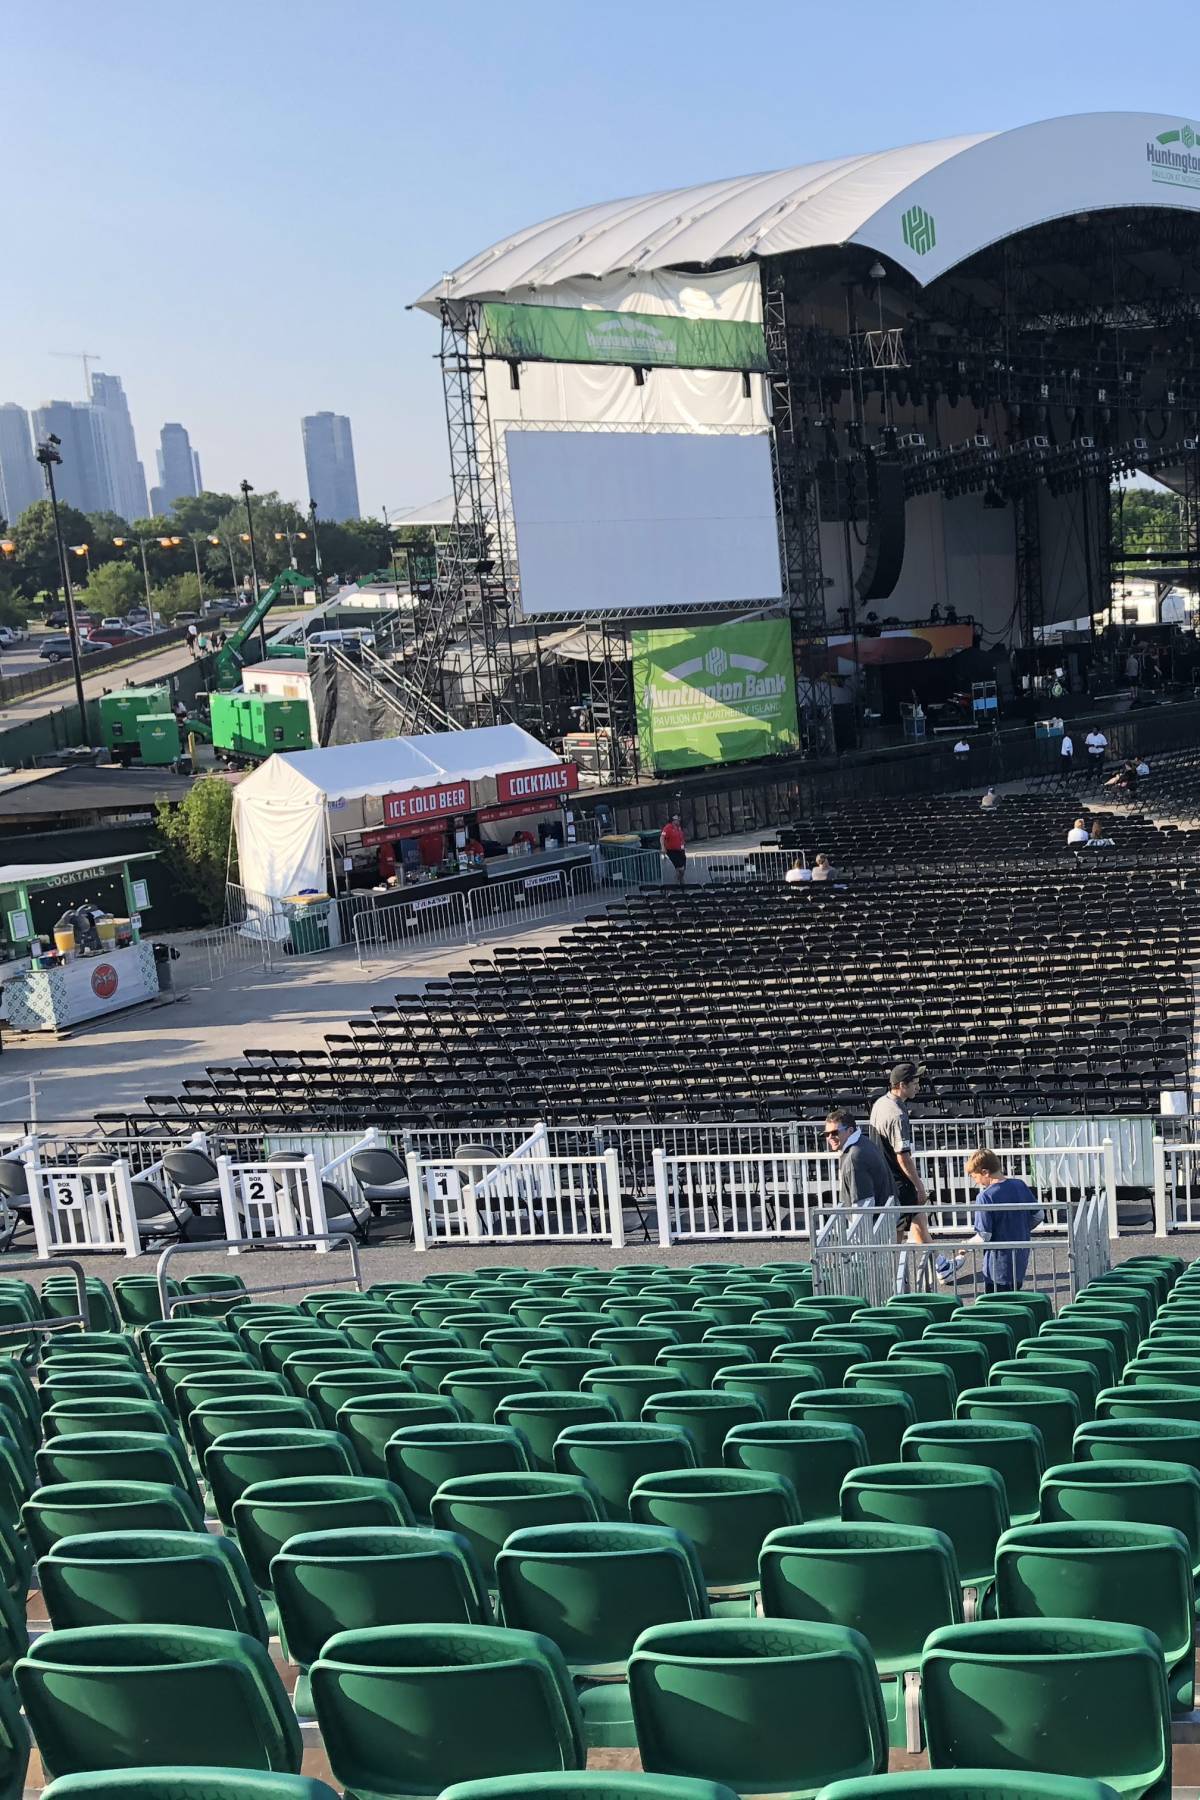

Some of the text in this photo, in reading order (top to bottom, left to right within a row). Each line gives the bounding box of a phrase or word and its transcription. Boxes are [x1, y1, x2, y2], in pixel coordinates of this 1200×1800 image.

[644, 674, 786, 708] Huntington Bank
[654, 713, 690, 726] PAVILION
[691, 711, 702, 721] AT
[509, 770, 568, 796] COCKTAILS
[389, 788, 466, 818] ICE COLD BEER
[47, 866, 106, 888] COCKTAILS
[58, 1188, 74, 1206] 3
[249, 1182, 266, 1200] 2
[437, 1178, 448, 1196] 1
